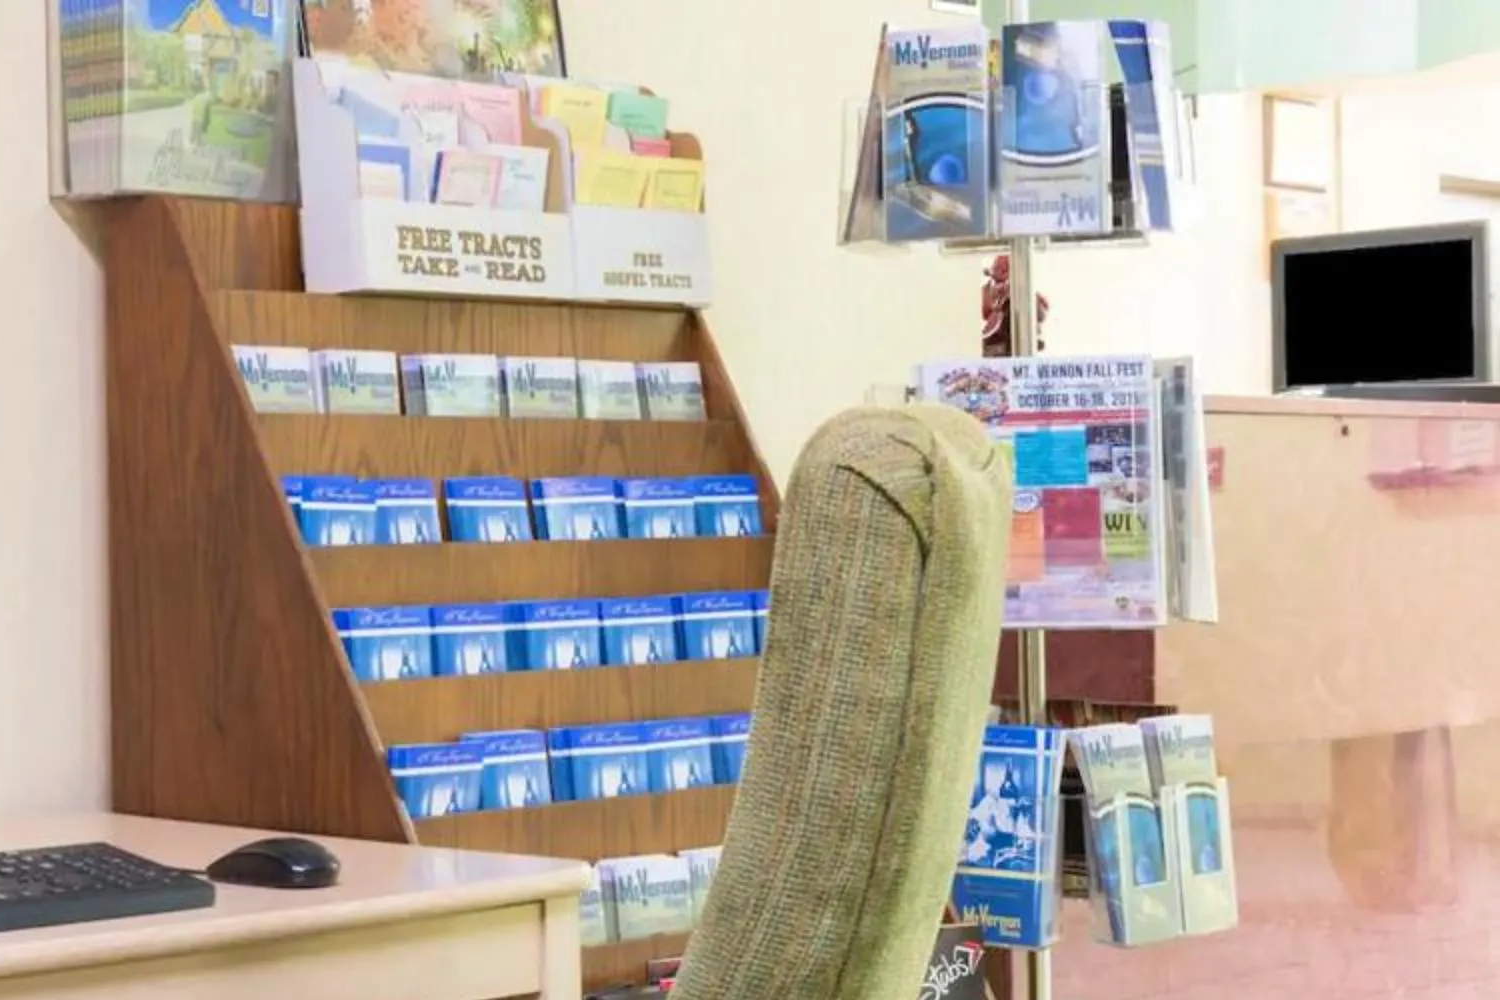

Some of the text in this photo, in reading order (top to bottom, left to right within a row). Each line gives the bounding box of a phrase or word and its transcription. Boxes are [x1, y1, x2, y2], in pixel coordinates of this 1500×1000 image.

[397, 225, 542, 260] FREE TRACTS
[633, 252, 663, 268] FREE
[397, 254, 460, 277] TAKE
[485, 260, 546, 284] READ
[1037, 363, 1084, 379] VERNON
[1086, 363, 1112, 378] FALL
[1116, 362, 1144, 377] FEST
[1017, 392, 1070, 408] OCTOBER
